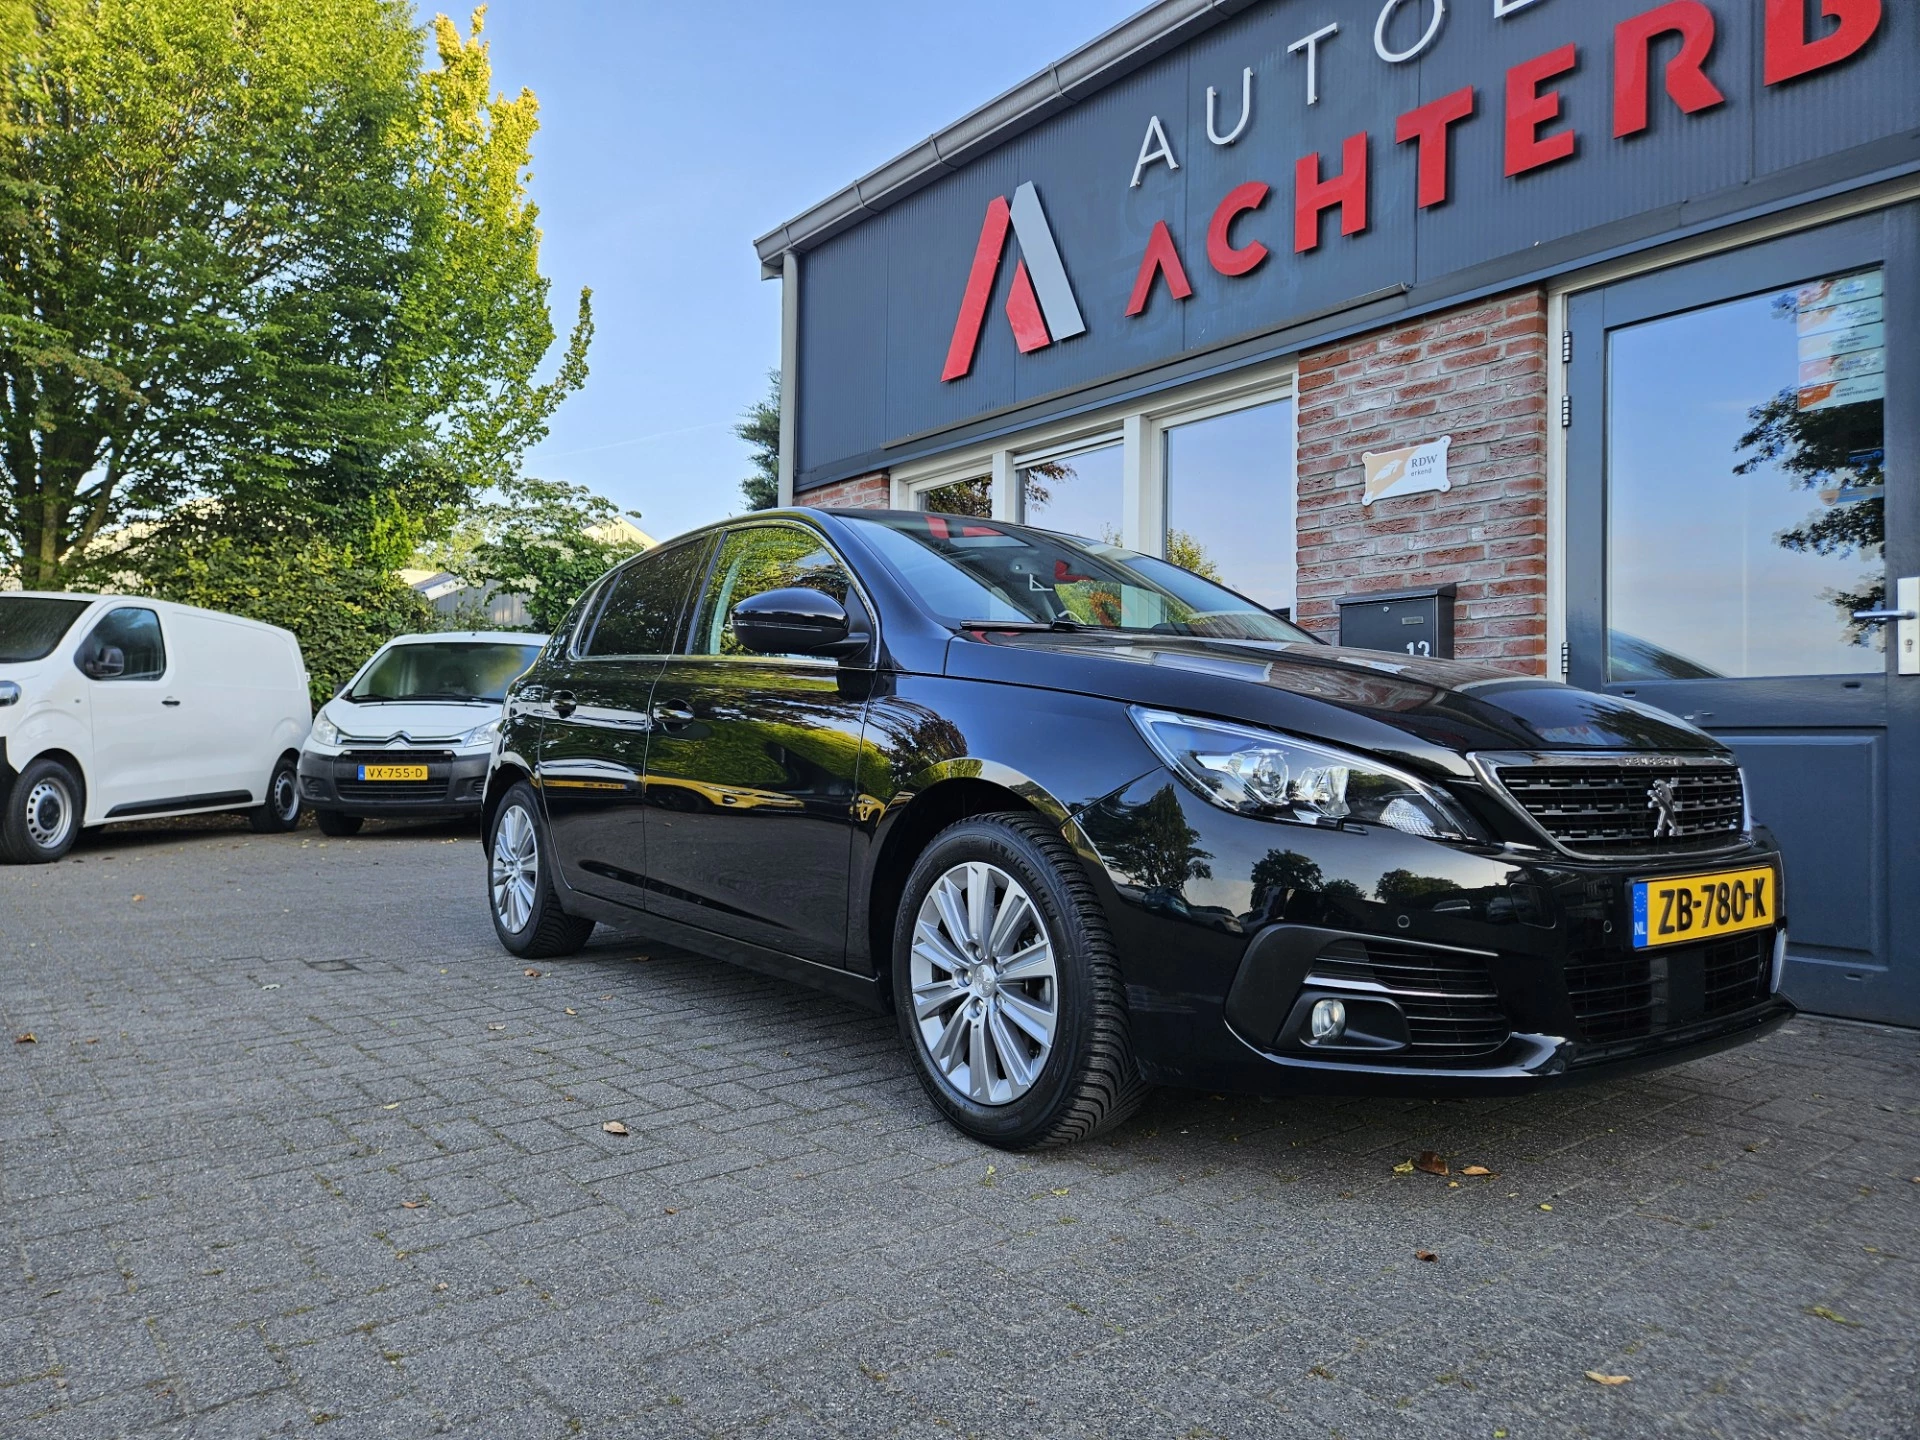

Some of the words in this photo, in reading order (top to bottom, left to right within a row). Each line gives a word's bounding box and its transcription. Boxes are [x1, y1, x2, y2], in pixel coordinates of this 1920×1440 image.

[1129, 0, 1538, 189] AUTO
[1411, 454, 1438, 468] RDW
[1410, 467, 1432, 477] erkend
[368, 768, 423, 778] VX-755-D
[1634, 922, 1647, 935] NL
[1658, 877, 1766, 935] ZB-780-K
